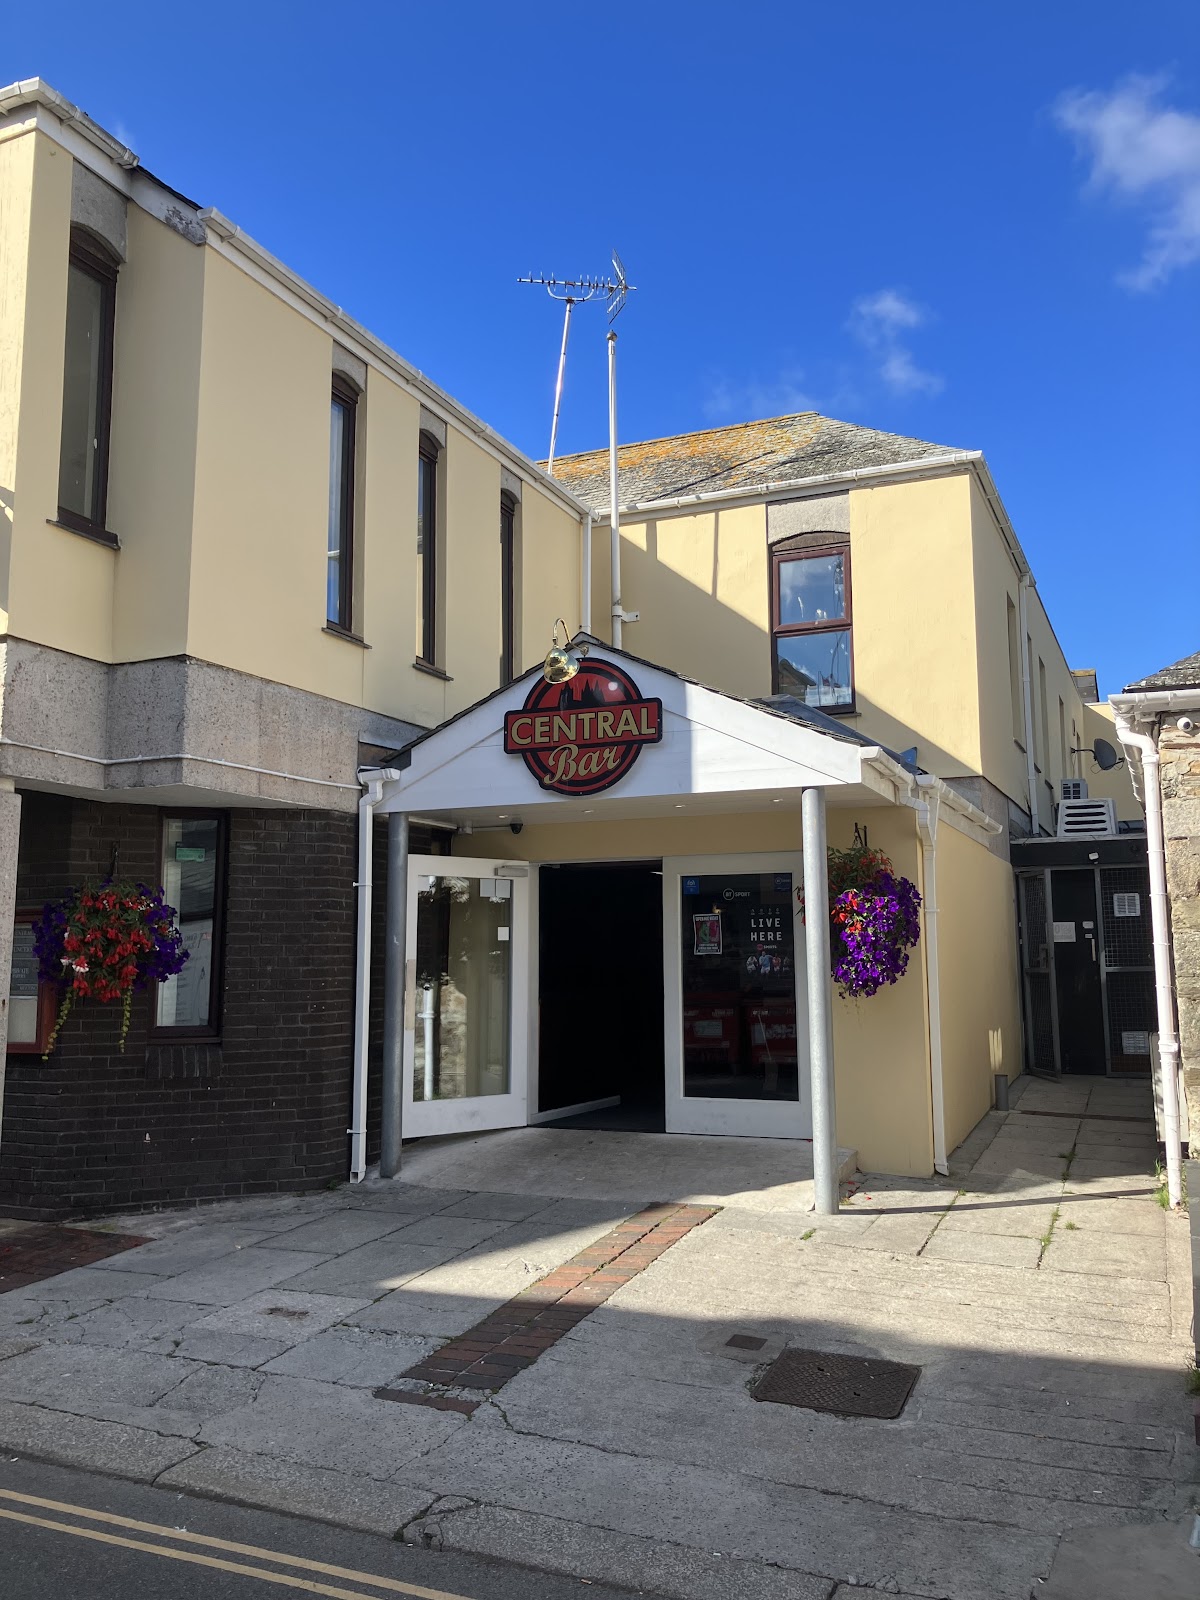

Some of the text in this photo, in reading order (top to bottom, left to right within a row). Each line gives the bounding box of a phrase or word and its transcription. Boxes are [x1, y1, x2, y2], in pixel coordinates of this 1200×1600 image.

[511, 707, 656, 745] CENTRAL
[543, 743, 621, 785] Bar
[751, 918, 781, 928] LIVE
[750, 931, 783, 942] HERE
